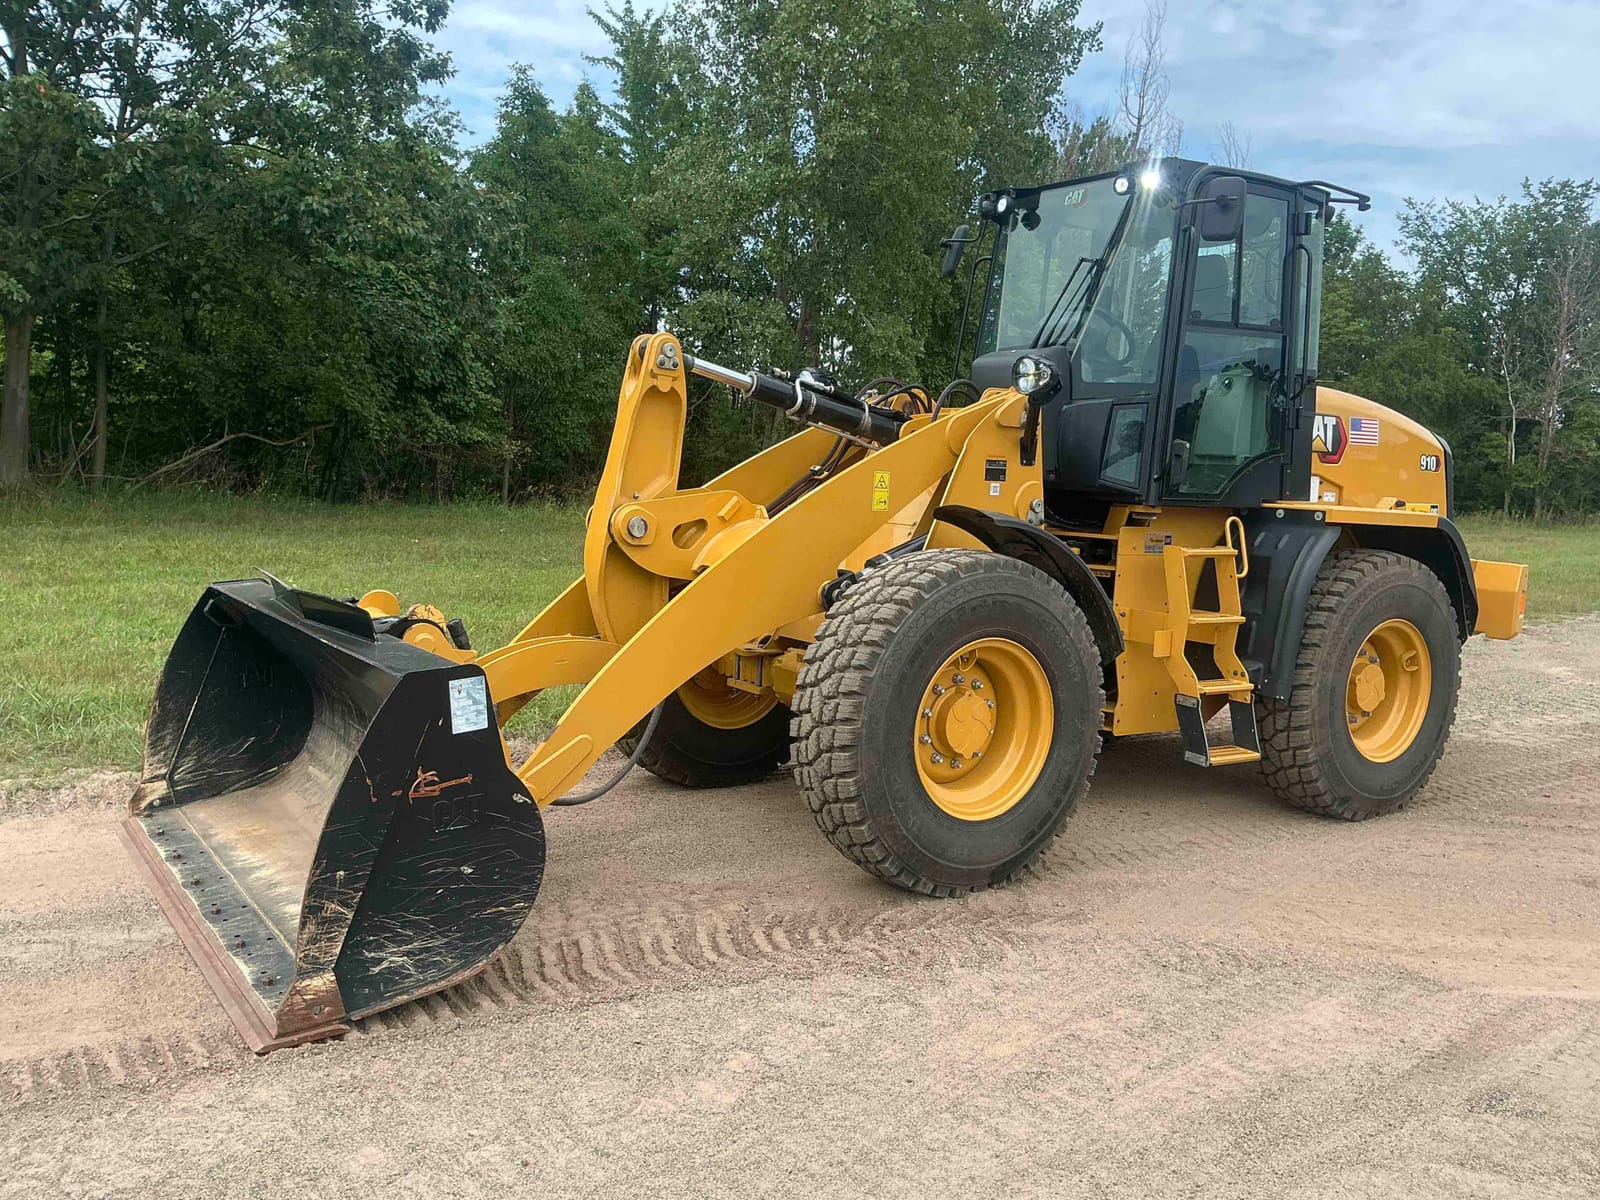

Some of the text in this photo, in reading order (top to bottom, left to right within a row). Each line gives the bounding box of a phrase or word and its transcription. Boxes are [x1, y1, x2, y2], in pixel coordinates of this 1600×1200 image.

[1064, 189, 1086, 206] CAT
[1312, 415, 1337, 453] AT
[1420, 455, 1437, 471] 910
